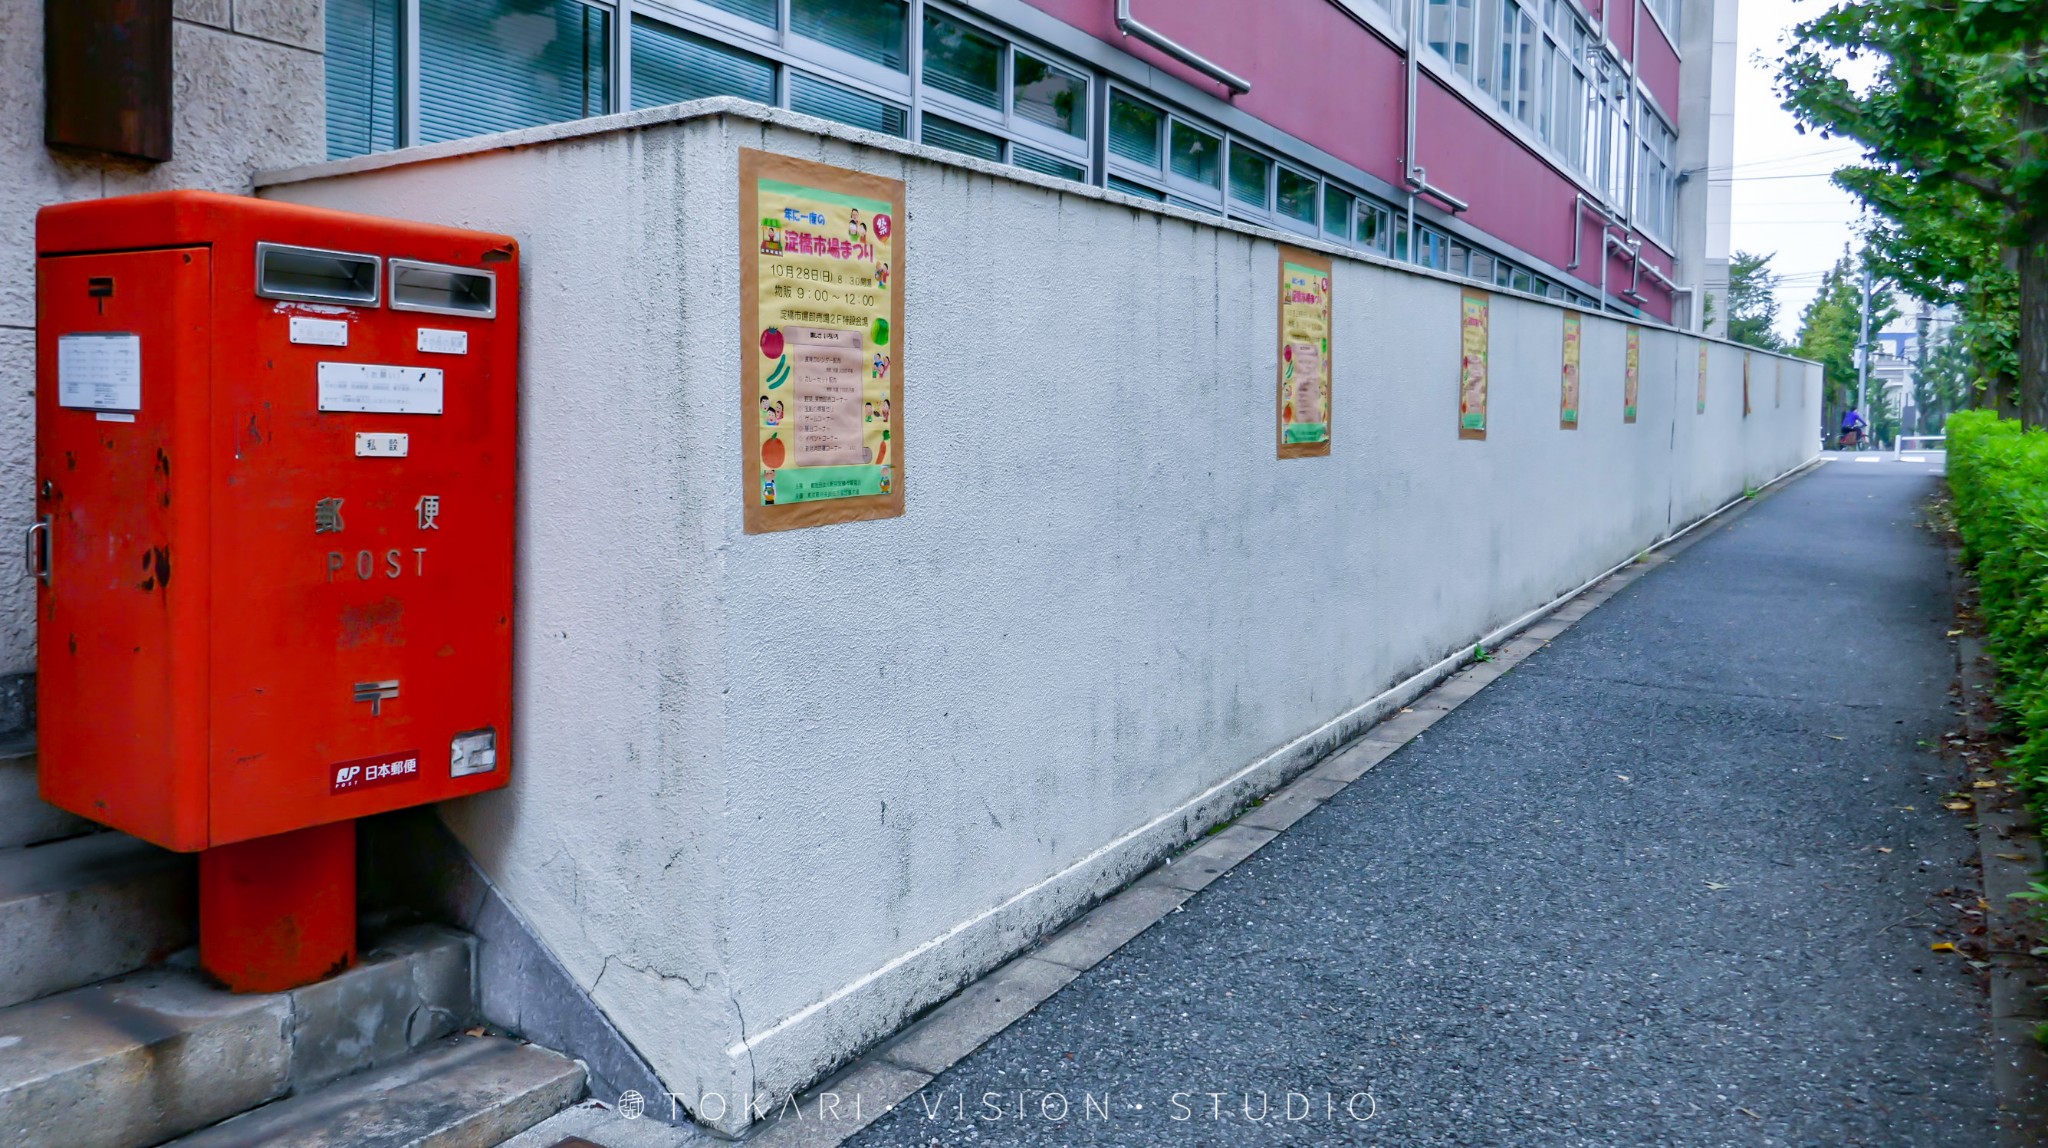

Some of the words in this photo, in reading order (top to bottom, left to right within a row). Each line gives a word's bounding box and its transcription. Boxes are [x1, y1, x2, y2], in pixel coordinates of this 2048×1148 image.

[784, 207, 825, 226] 年に一度の
[877, 217, 888, 236] 祭
[784, 230, 874, 263] 淀橋市場まつり
[770, 264, 833, 283] 10月28日(日)
[774, 284, 792, 299] 物販
[314, 495, 440, 533] 郵便
[327, 547, 428, 583] POST
[365, 758, 416, 781] 日本郵便
